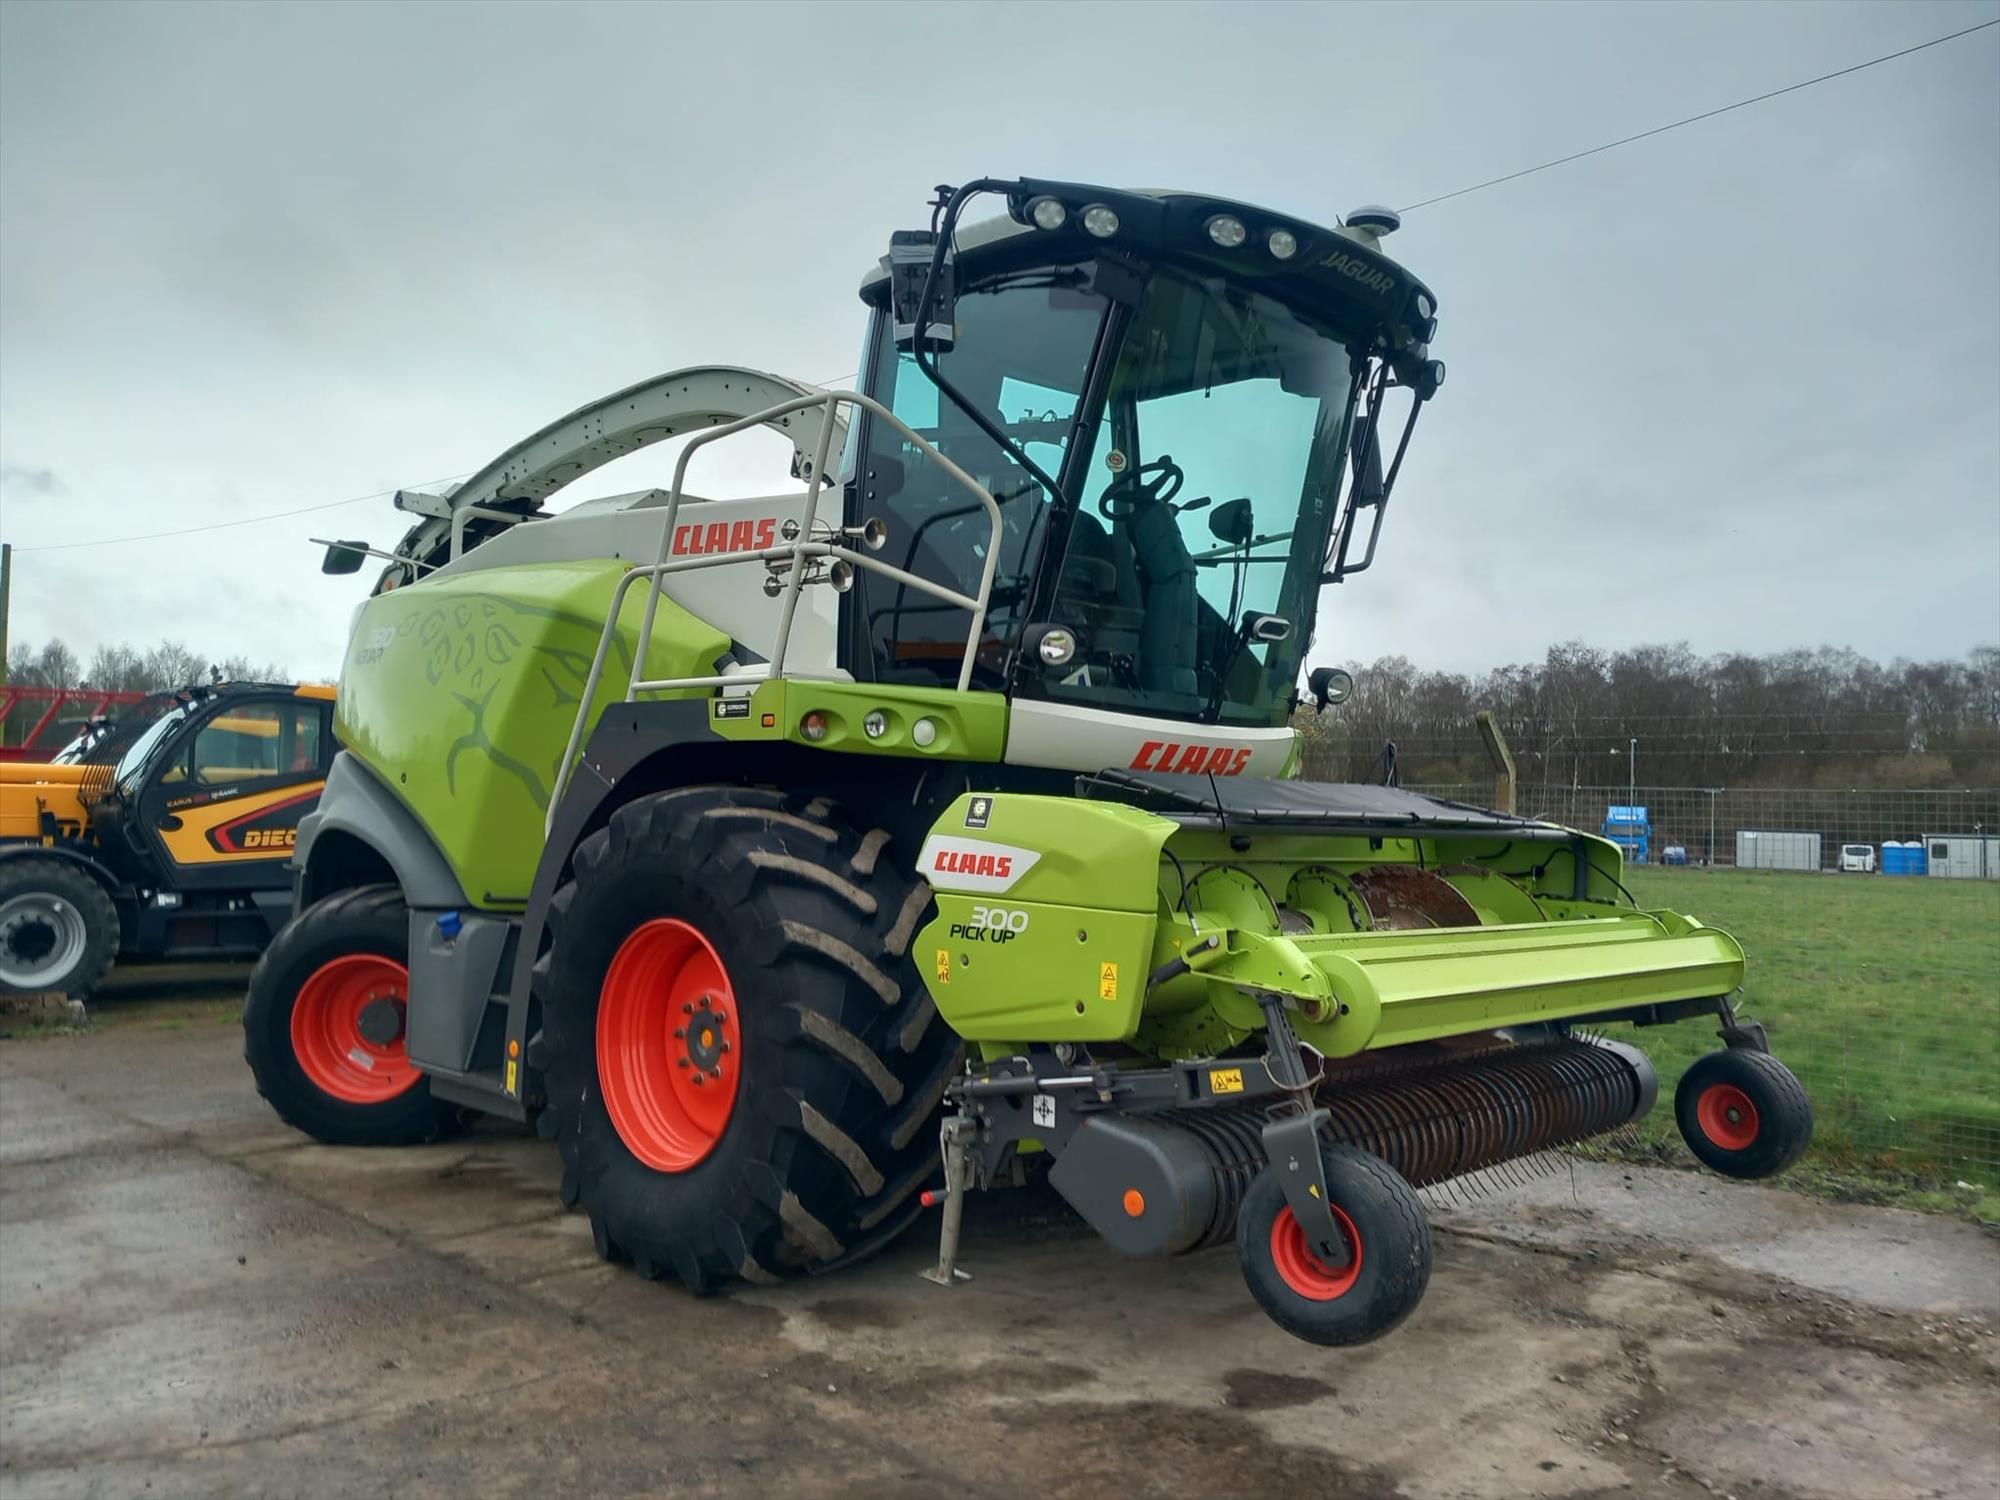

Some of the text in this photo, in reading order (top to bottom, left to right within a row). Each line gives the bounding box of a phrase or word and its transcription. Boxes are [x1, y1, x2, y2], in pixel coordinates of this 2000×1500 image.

[1319, 251, 1396, 295] JAGUAR
[672, 518, 777, 555] CLAAS
[1130, 741, 1254, 777] CLAAS
[934, 851, 1013, 878] CLAAS
[949, 924, 1016, 944] PICK UP
[970, 906, 1029, 933] 300
